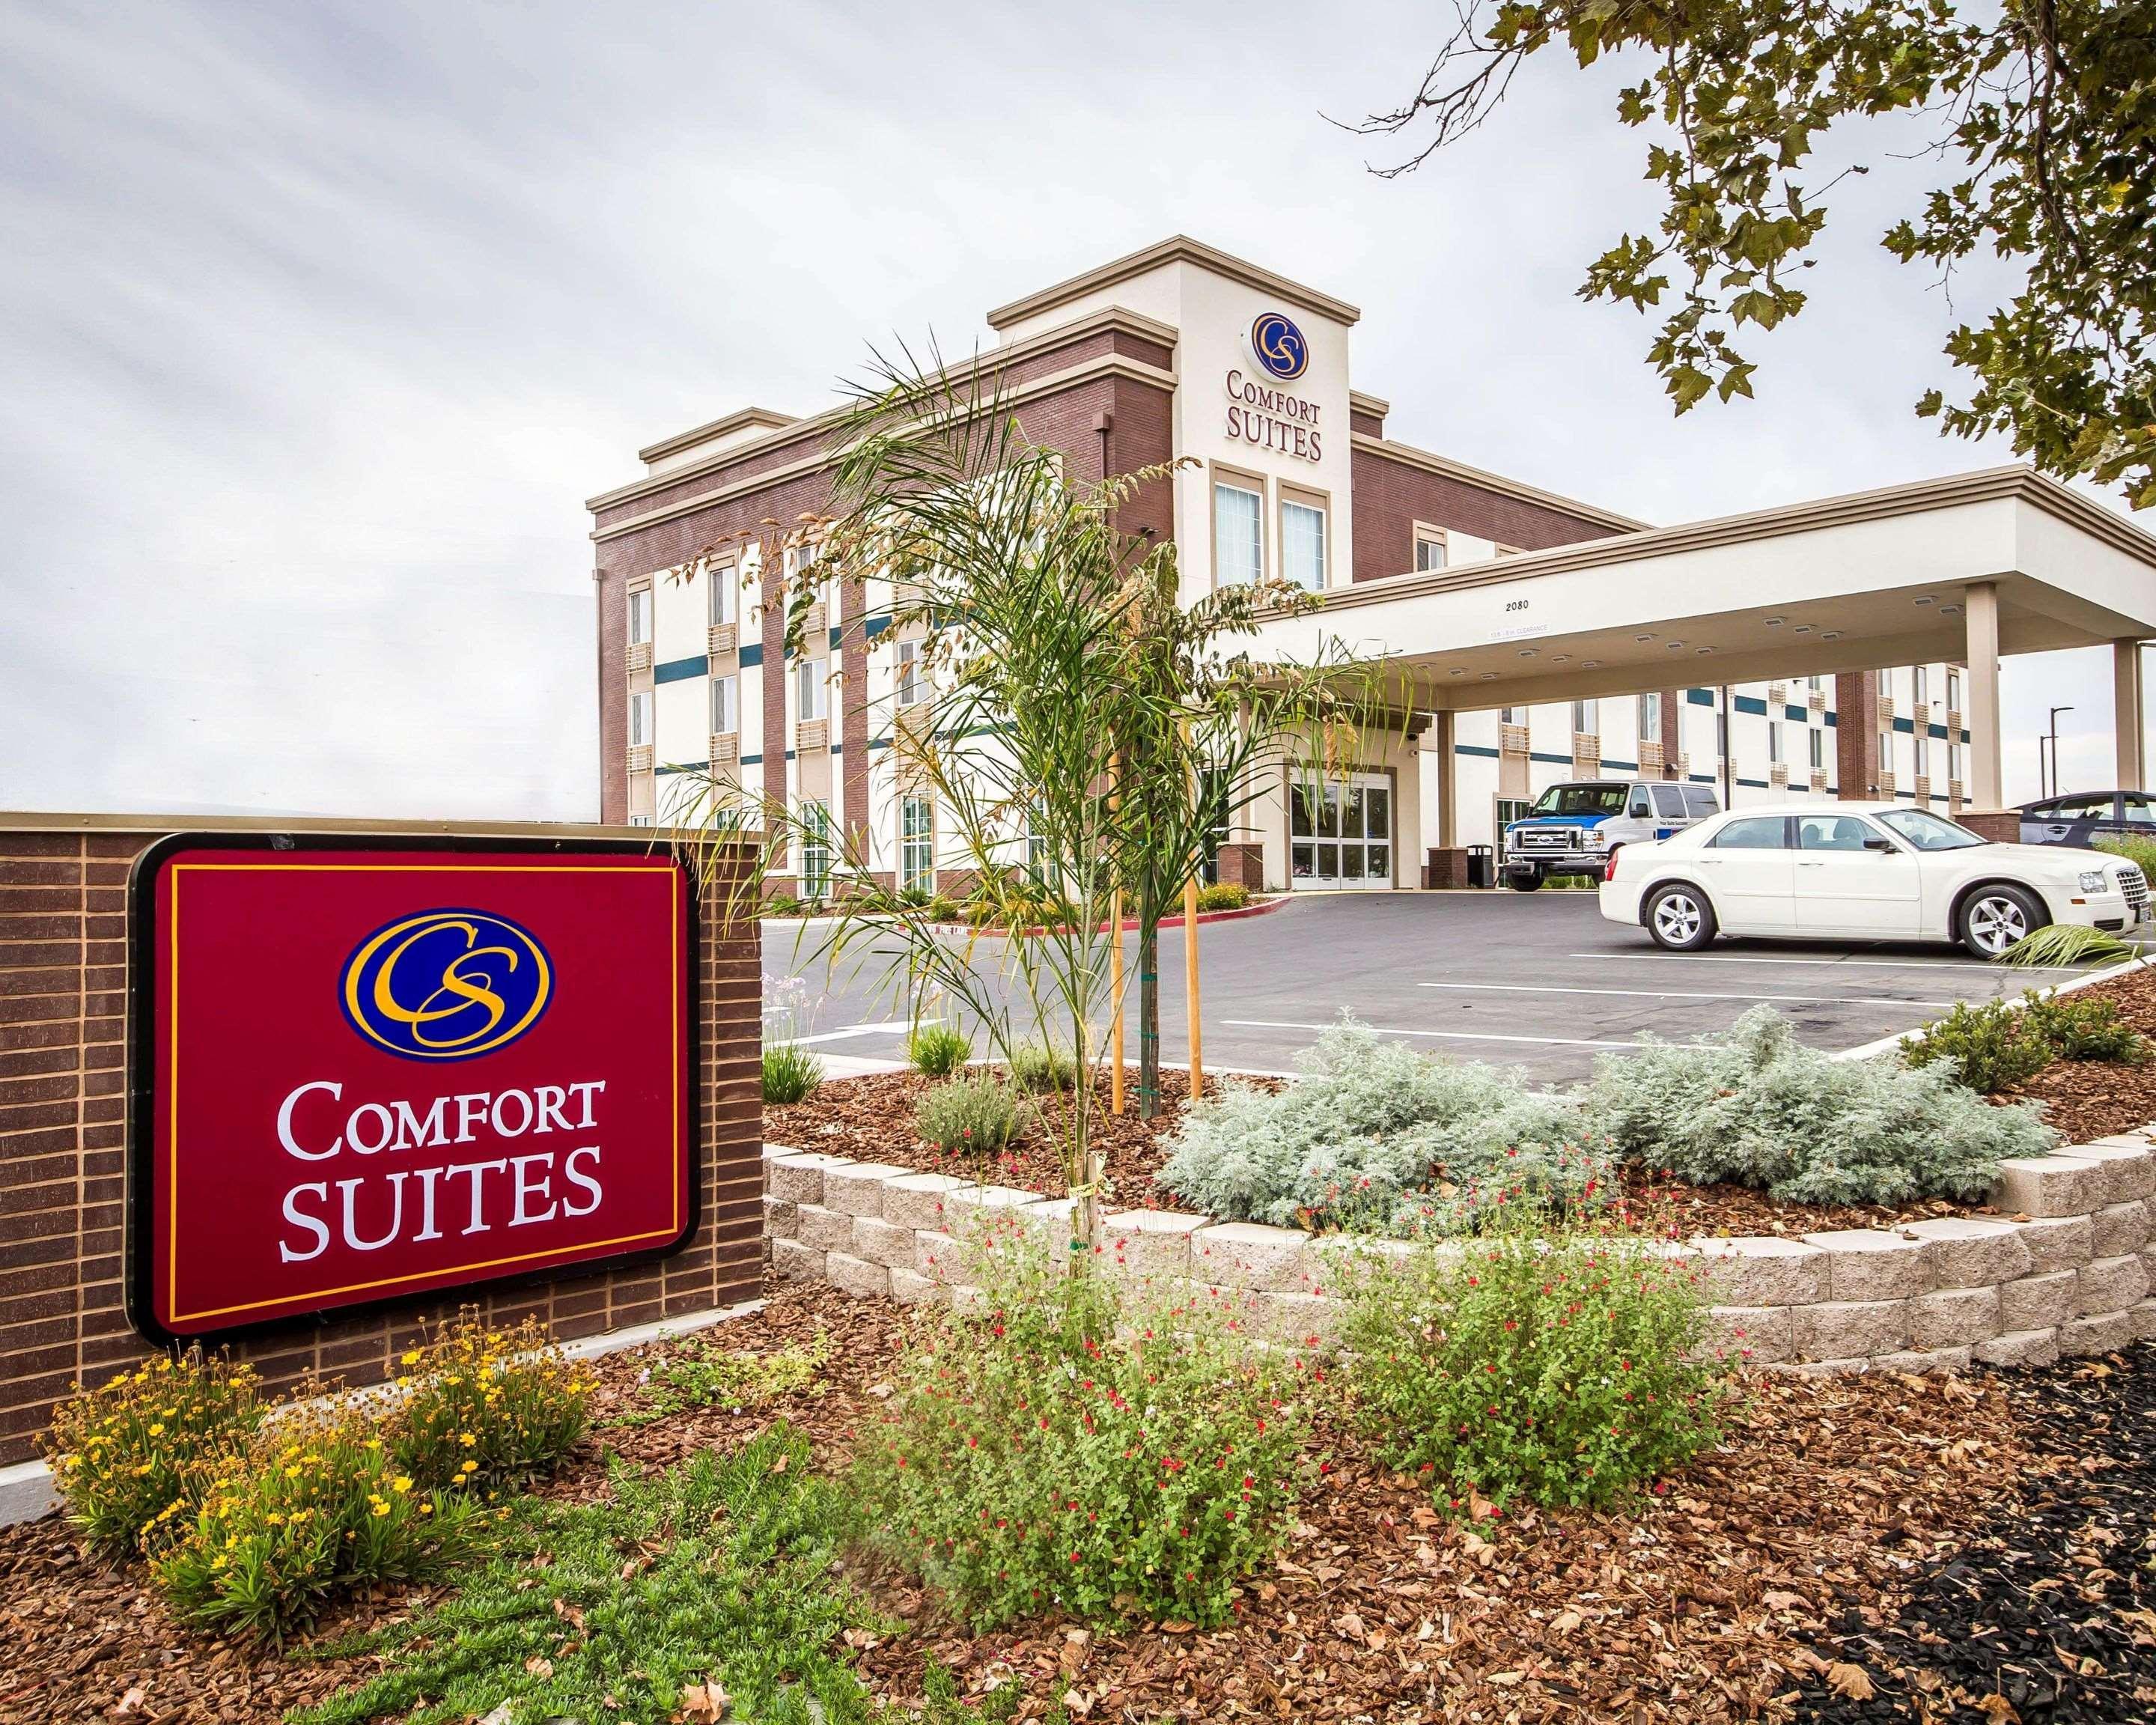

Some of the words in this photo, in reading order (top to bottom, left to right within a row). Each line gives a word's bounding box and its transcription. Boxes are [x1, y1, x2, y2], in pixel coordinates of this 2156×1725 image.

[1226, 369, 1321, 425] COMFORT
[1227, 406, 1322, 462] SUITES
[1505, 600, 1529, 612] 2080
[940, 927, 952, 935] FIRE
[276, 1079, 606, 1161] COMFORT
[278, 1145, 603, 1264] SUITES
